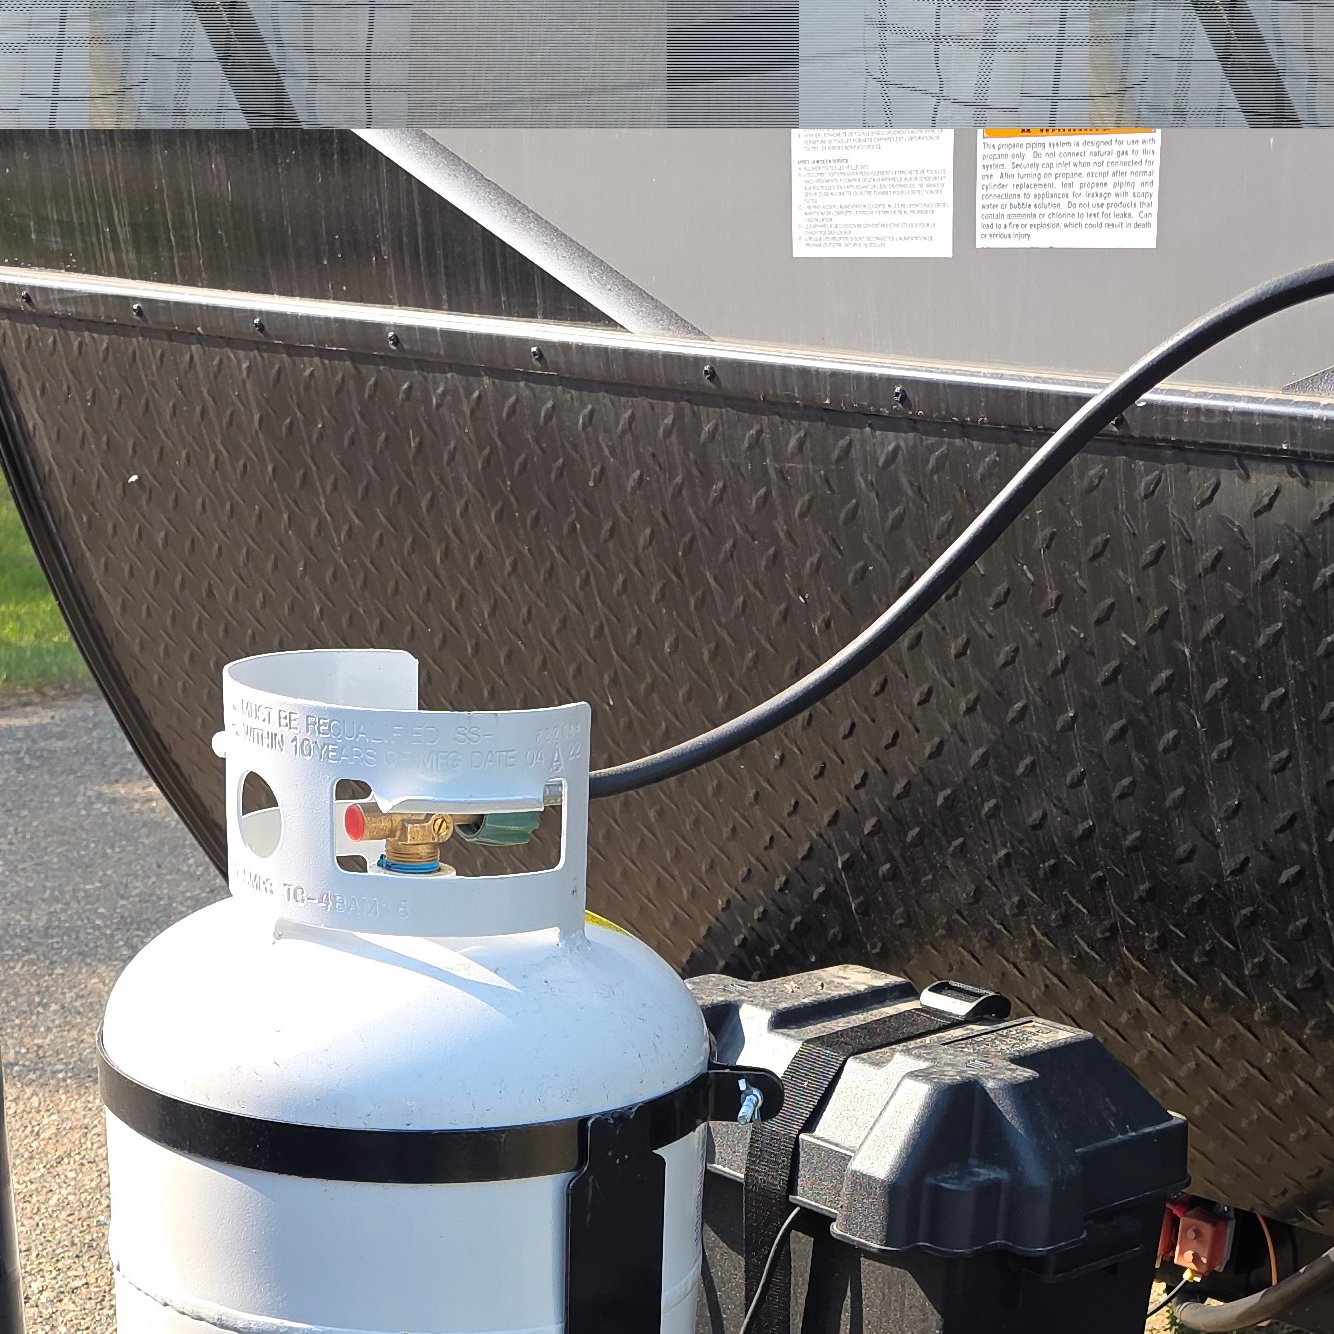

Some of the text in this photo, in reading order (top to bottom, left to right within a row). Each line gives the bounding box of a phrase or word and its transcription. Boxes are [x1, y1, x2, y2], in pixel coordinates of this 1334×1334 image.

[242, 724, 284, 752] WITHIN
[291, 736, 314, 760] 10
[314, 742, 376, 768] YEARS
[384, 749, 414, 768] OF
[422, 752, 461, 770] MFG
[471, 750, 517, 768] DATE
[526, 750, 545, 768] 04
[278, 710, 299, 731] BE
[306, 715, 440, 746] REQUALIFIED
